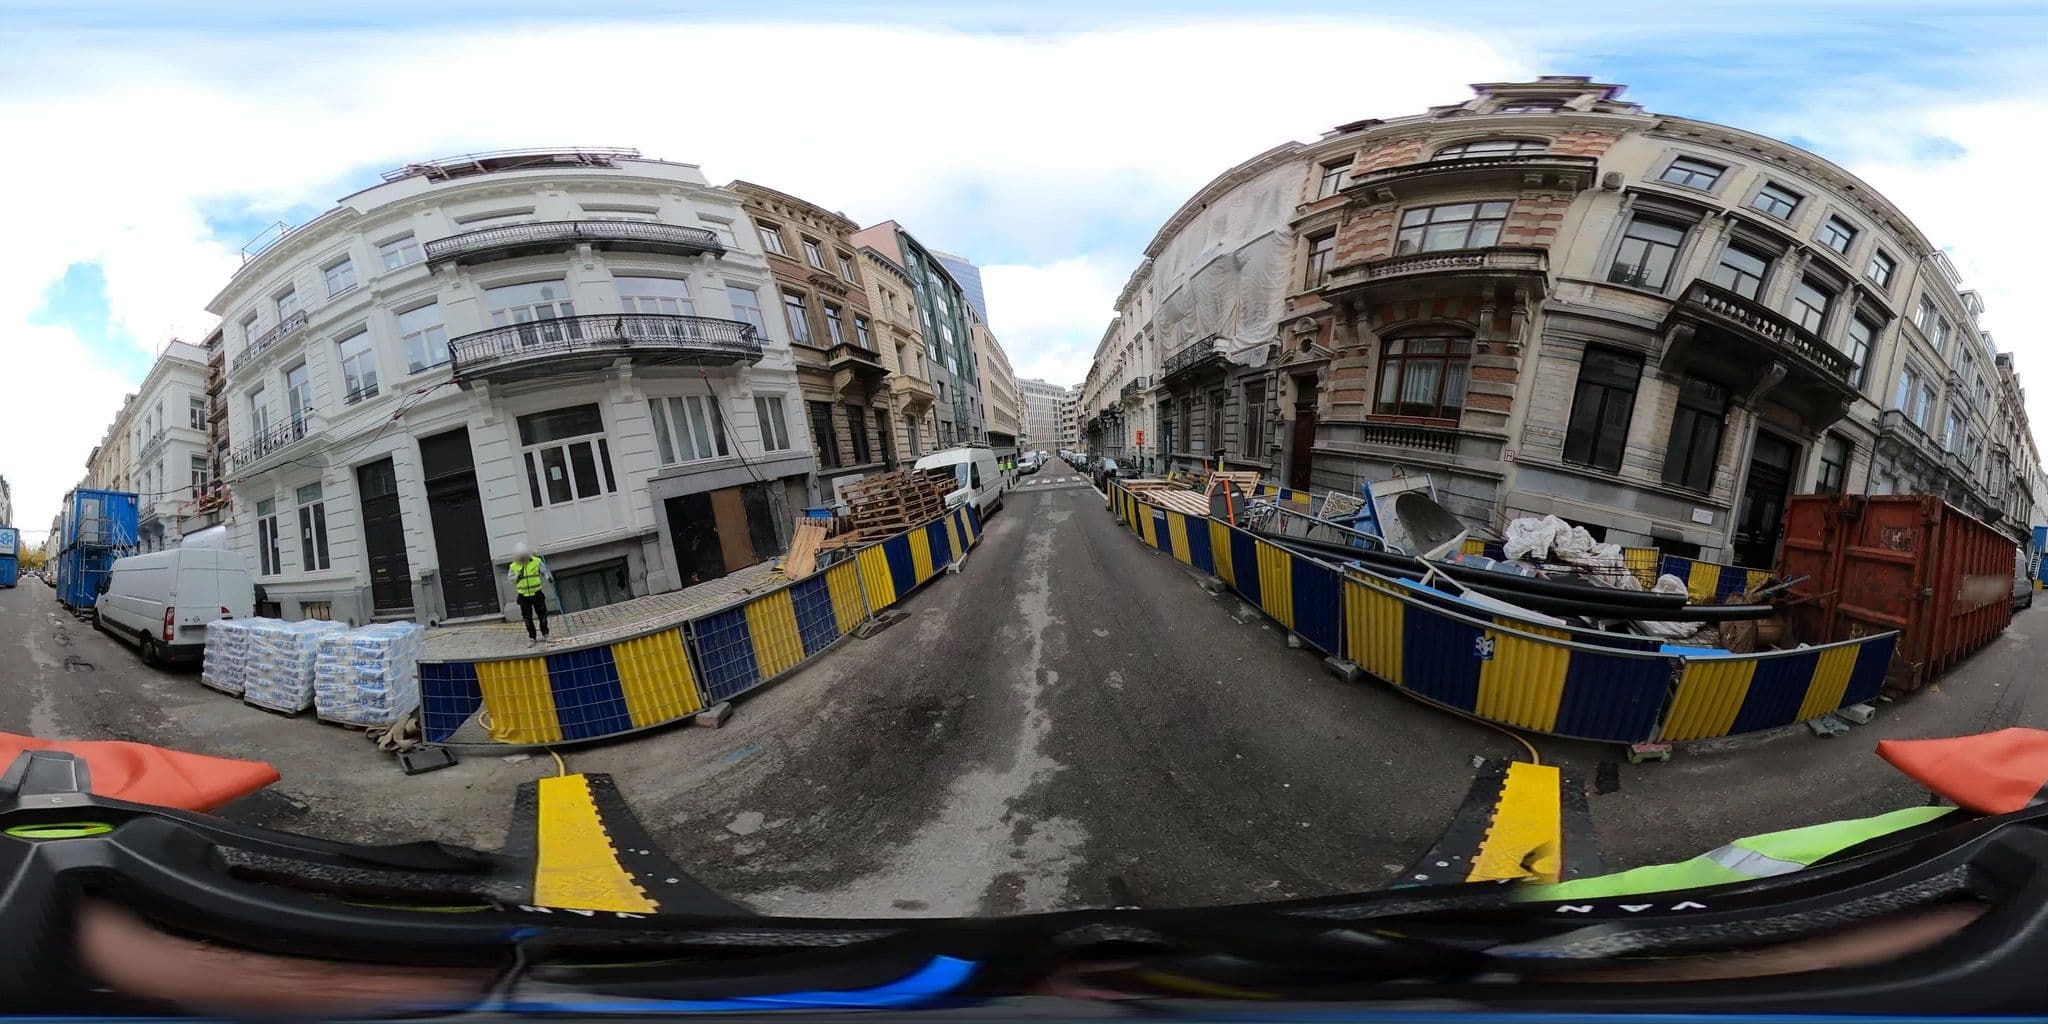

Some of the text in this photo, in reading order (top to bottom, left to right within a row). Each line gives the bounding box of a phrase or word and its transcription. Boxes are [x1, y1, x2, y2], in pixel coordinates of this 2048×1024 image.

[352, 639, 381, 648] MP 75
[352, 659, 366, 667] MP
[371, 700, 385, 709] 75
